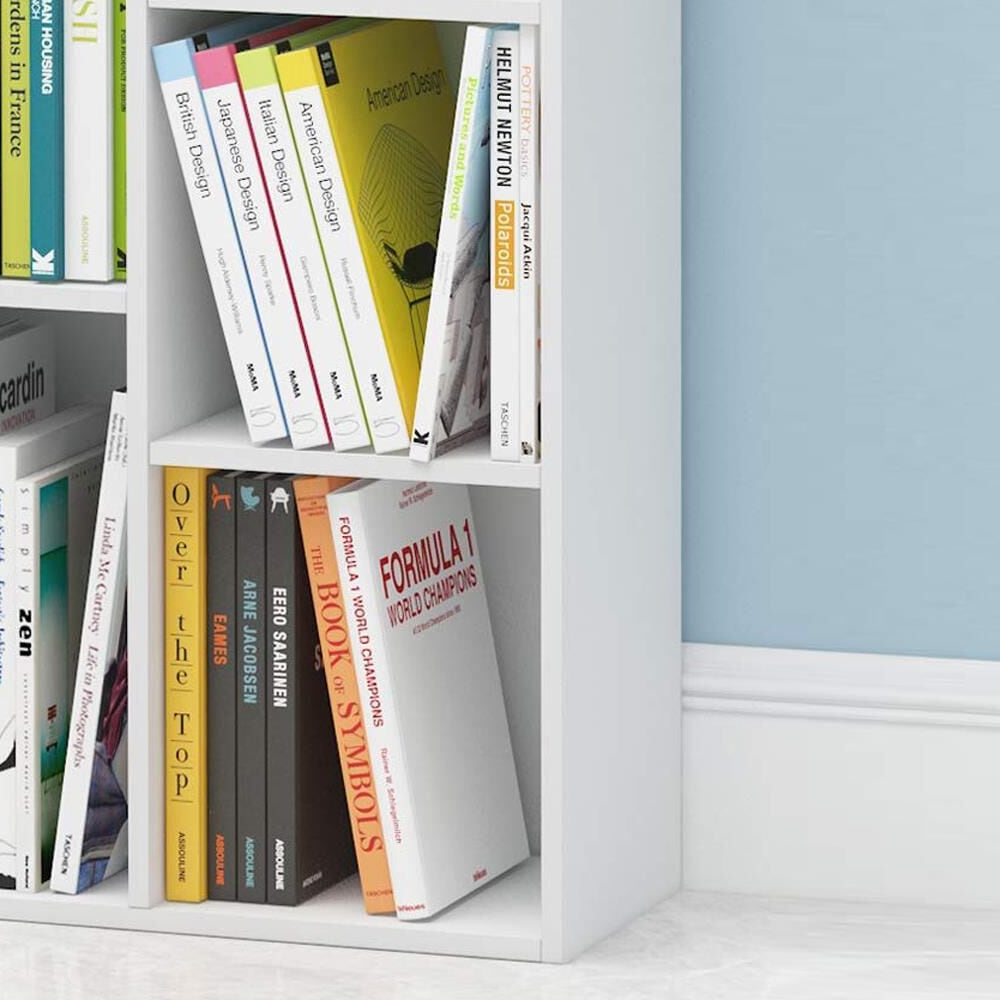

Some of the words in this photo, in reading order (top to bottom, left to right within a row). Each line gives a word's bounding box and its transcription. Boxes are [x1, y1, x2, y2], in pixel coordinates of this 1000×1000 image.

[10, 62, 25, 82] in
[40, 27, 52, 95] HOUSING
[497, 47, 512, 114] HELMUT
[365, 82, 410, 113] American
[409, 67, 446, 97] Design
[458, 76, 478, 139] Pictures
[10, 89, 26, 158] France
[175, 91, 198, 143] British
[188, 145, 210, 199] Design
[258, 98, 276, 148] Italian
[270, 148, 293, 203] Design
[216, 98, 243, 174] Japanese
[236, 177, 260, 232] Design
[298, 101, 327, 177] American
[318, 178, 341, 234] Design
[455, 142, 467, 170] and
[497, 119, 512, 188] NEWTON
[450, 173, 463, 221] Words
[521, 203, 531, 236] Jacqui
[497, 202, 512, 287] Polaroids
[523, 239, 531, 280] Atkin
[0, 363, 45, 413] cardin
[413, 430, 429, 447] K
[500, 402, 509, 447] TASCHEN
[172, 482, 191, 582] Over
[310, 545, 325, 575] THE
[339, 516, 359, 581] FORMULA
[379, 524, 463, 599] FORMULA
[463, 518, 474, 557] 1
[243, 579, 256, 620] ARNE
[273, 587, 287, 626] EERO
[317, 582, 351, 667] BOOK
[353, 595, 370, 646] WORLD
[387, 592, 422, 628] WORLD
[424, 564, 477, 611] CHAMPIONS
[18, 609, 34, 657] zen
[175, 615, 188, 688] the
[214, 614, 227, 666] EAMES
[243, 624, 257, 704] JACOBSEN
[273, 630, 287, 708] SAARINEN
[333, 676, 345, 695] OF
[360, 643, 383, 728] CHAMPIONS
[173, 712, 190, 797] Top
[337, 701, 383, 855] SYMBOLS
[61, 833, 72, 875] TASCHEN
[178, 832, 186, 883] ASSOULINE
[215, 834, 225, 886] ASSOULINE
[245, 836, 254, 888] ASSOULINE
[275, 838, 284, 890] ASSOULINE
